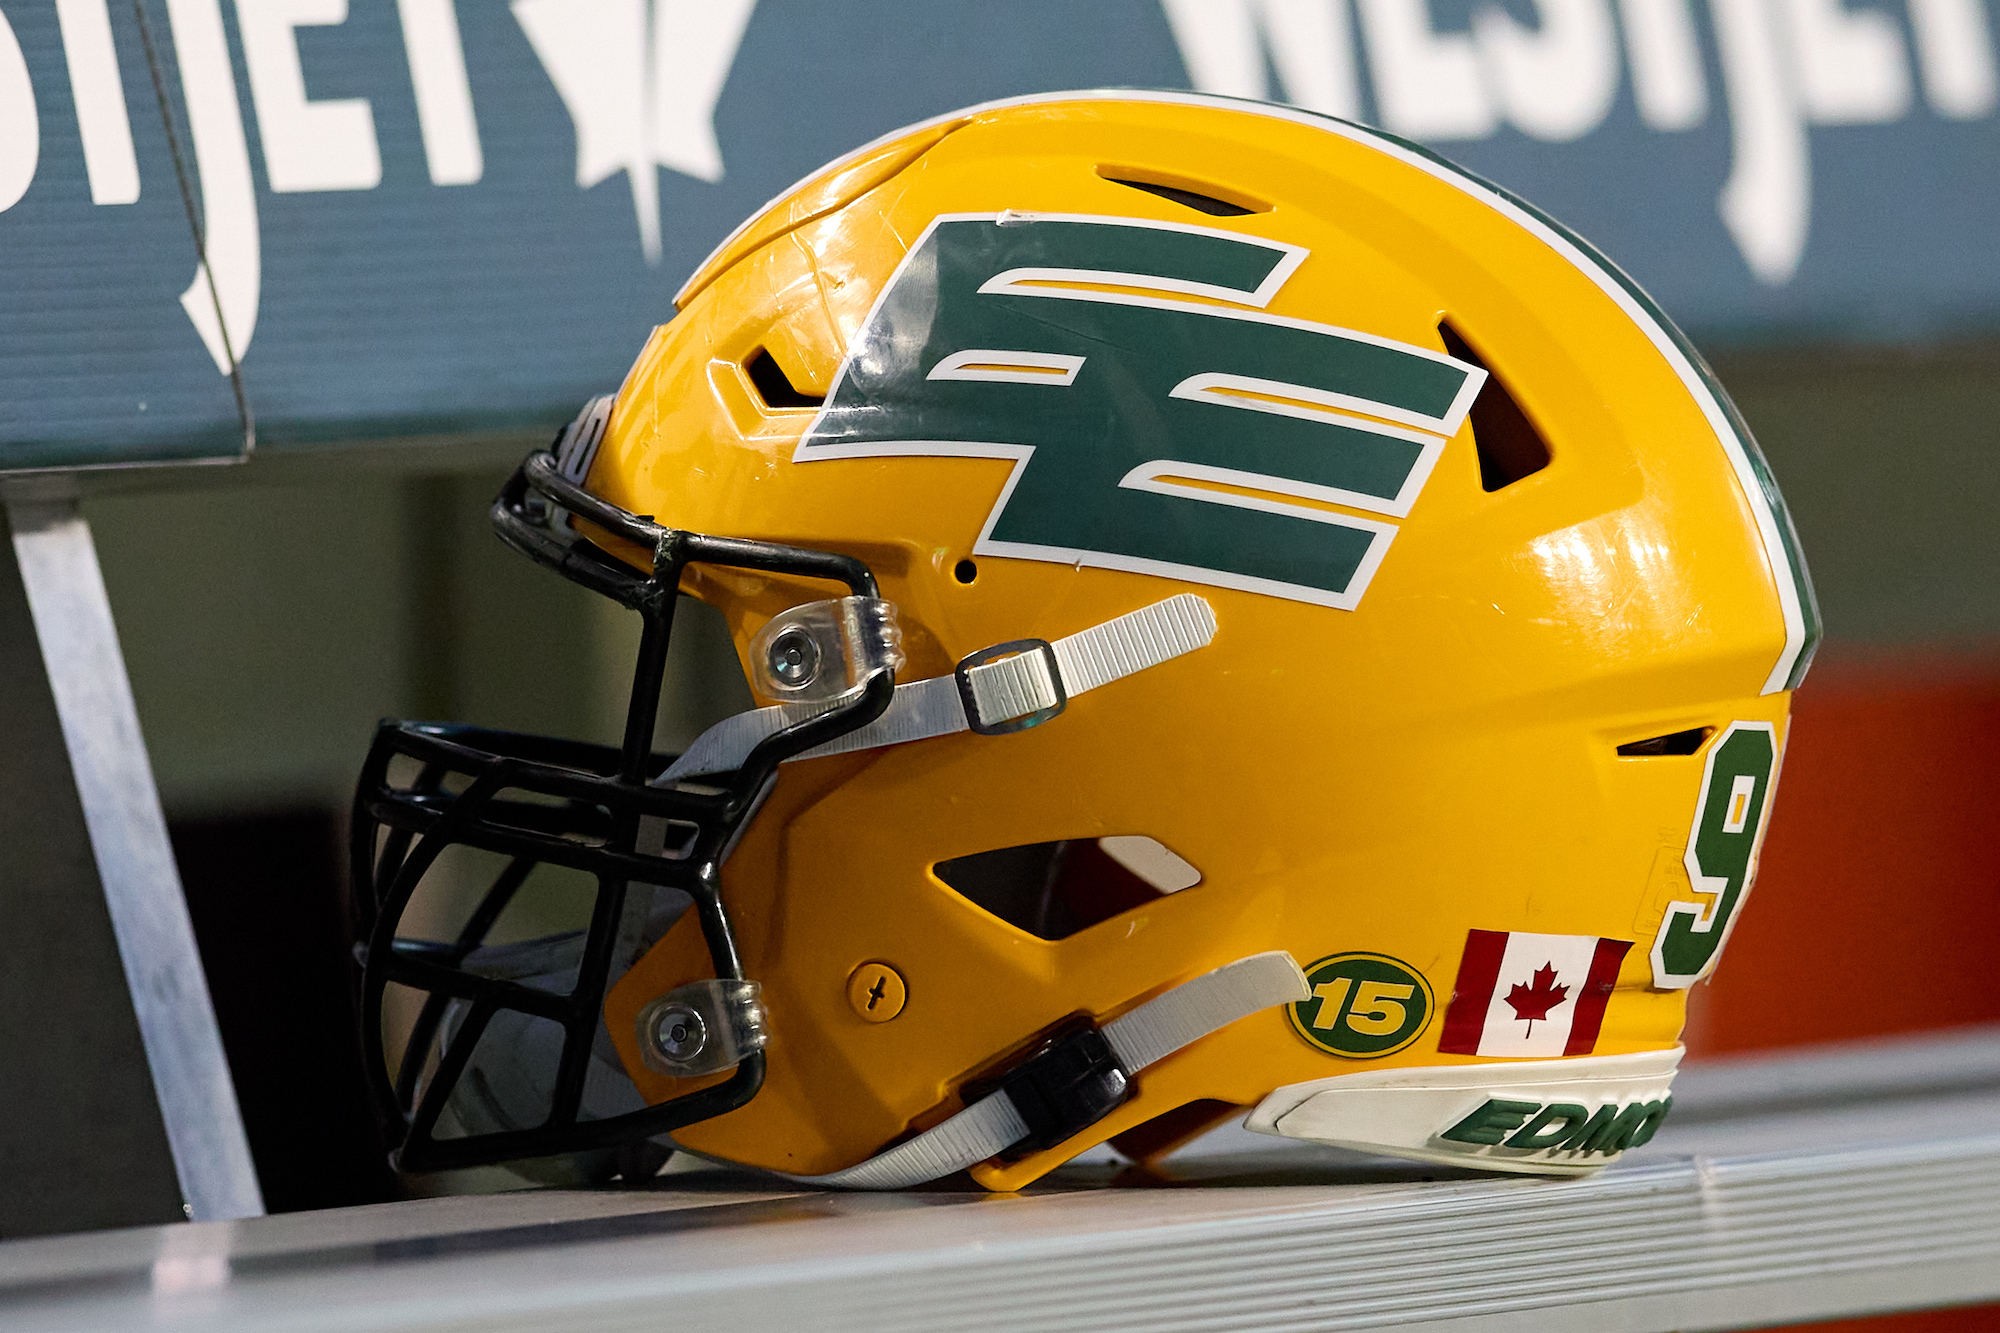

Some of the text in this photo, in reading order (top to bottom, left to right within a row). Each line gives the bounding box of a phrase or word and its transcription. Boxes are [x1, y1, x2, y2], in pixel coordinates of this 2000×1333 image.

[1650, 720, 1777, 988] 9
[1312, 976, 1415, 1036] 15
[1440, 1096, 1673, 1152] EDMO
